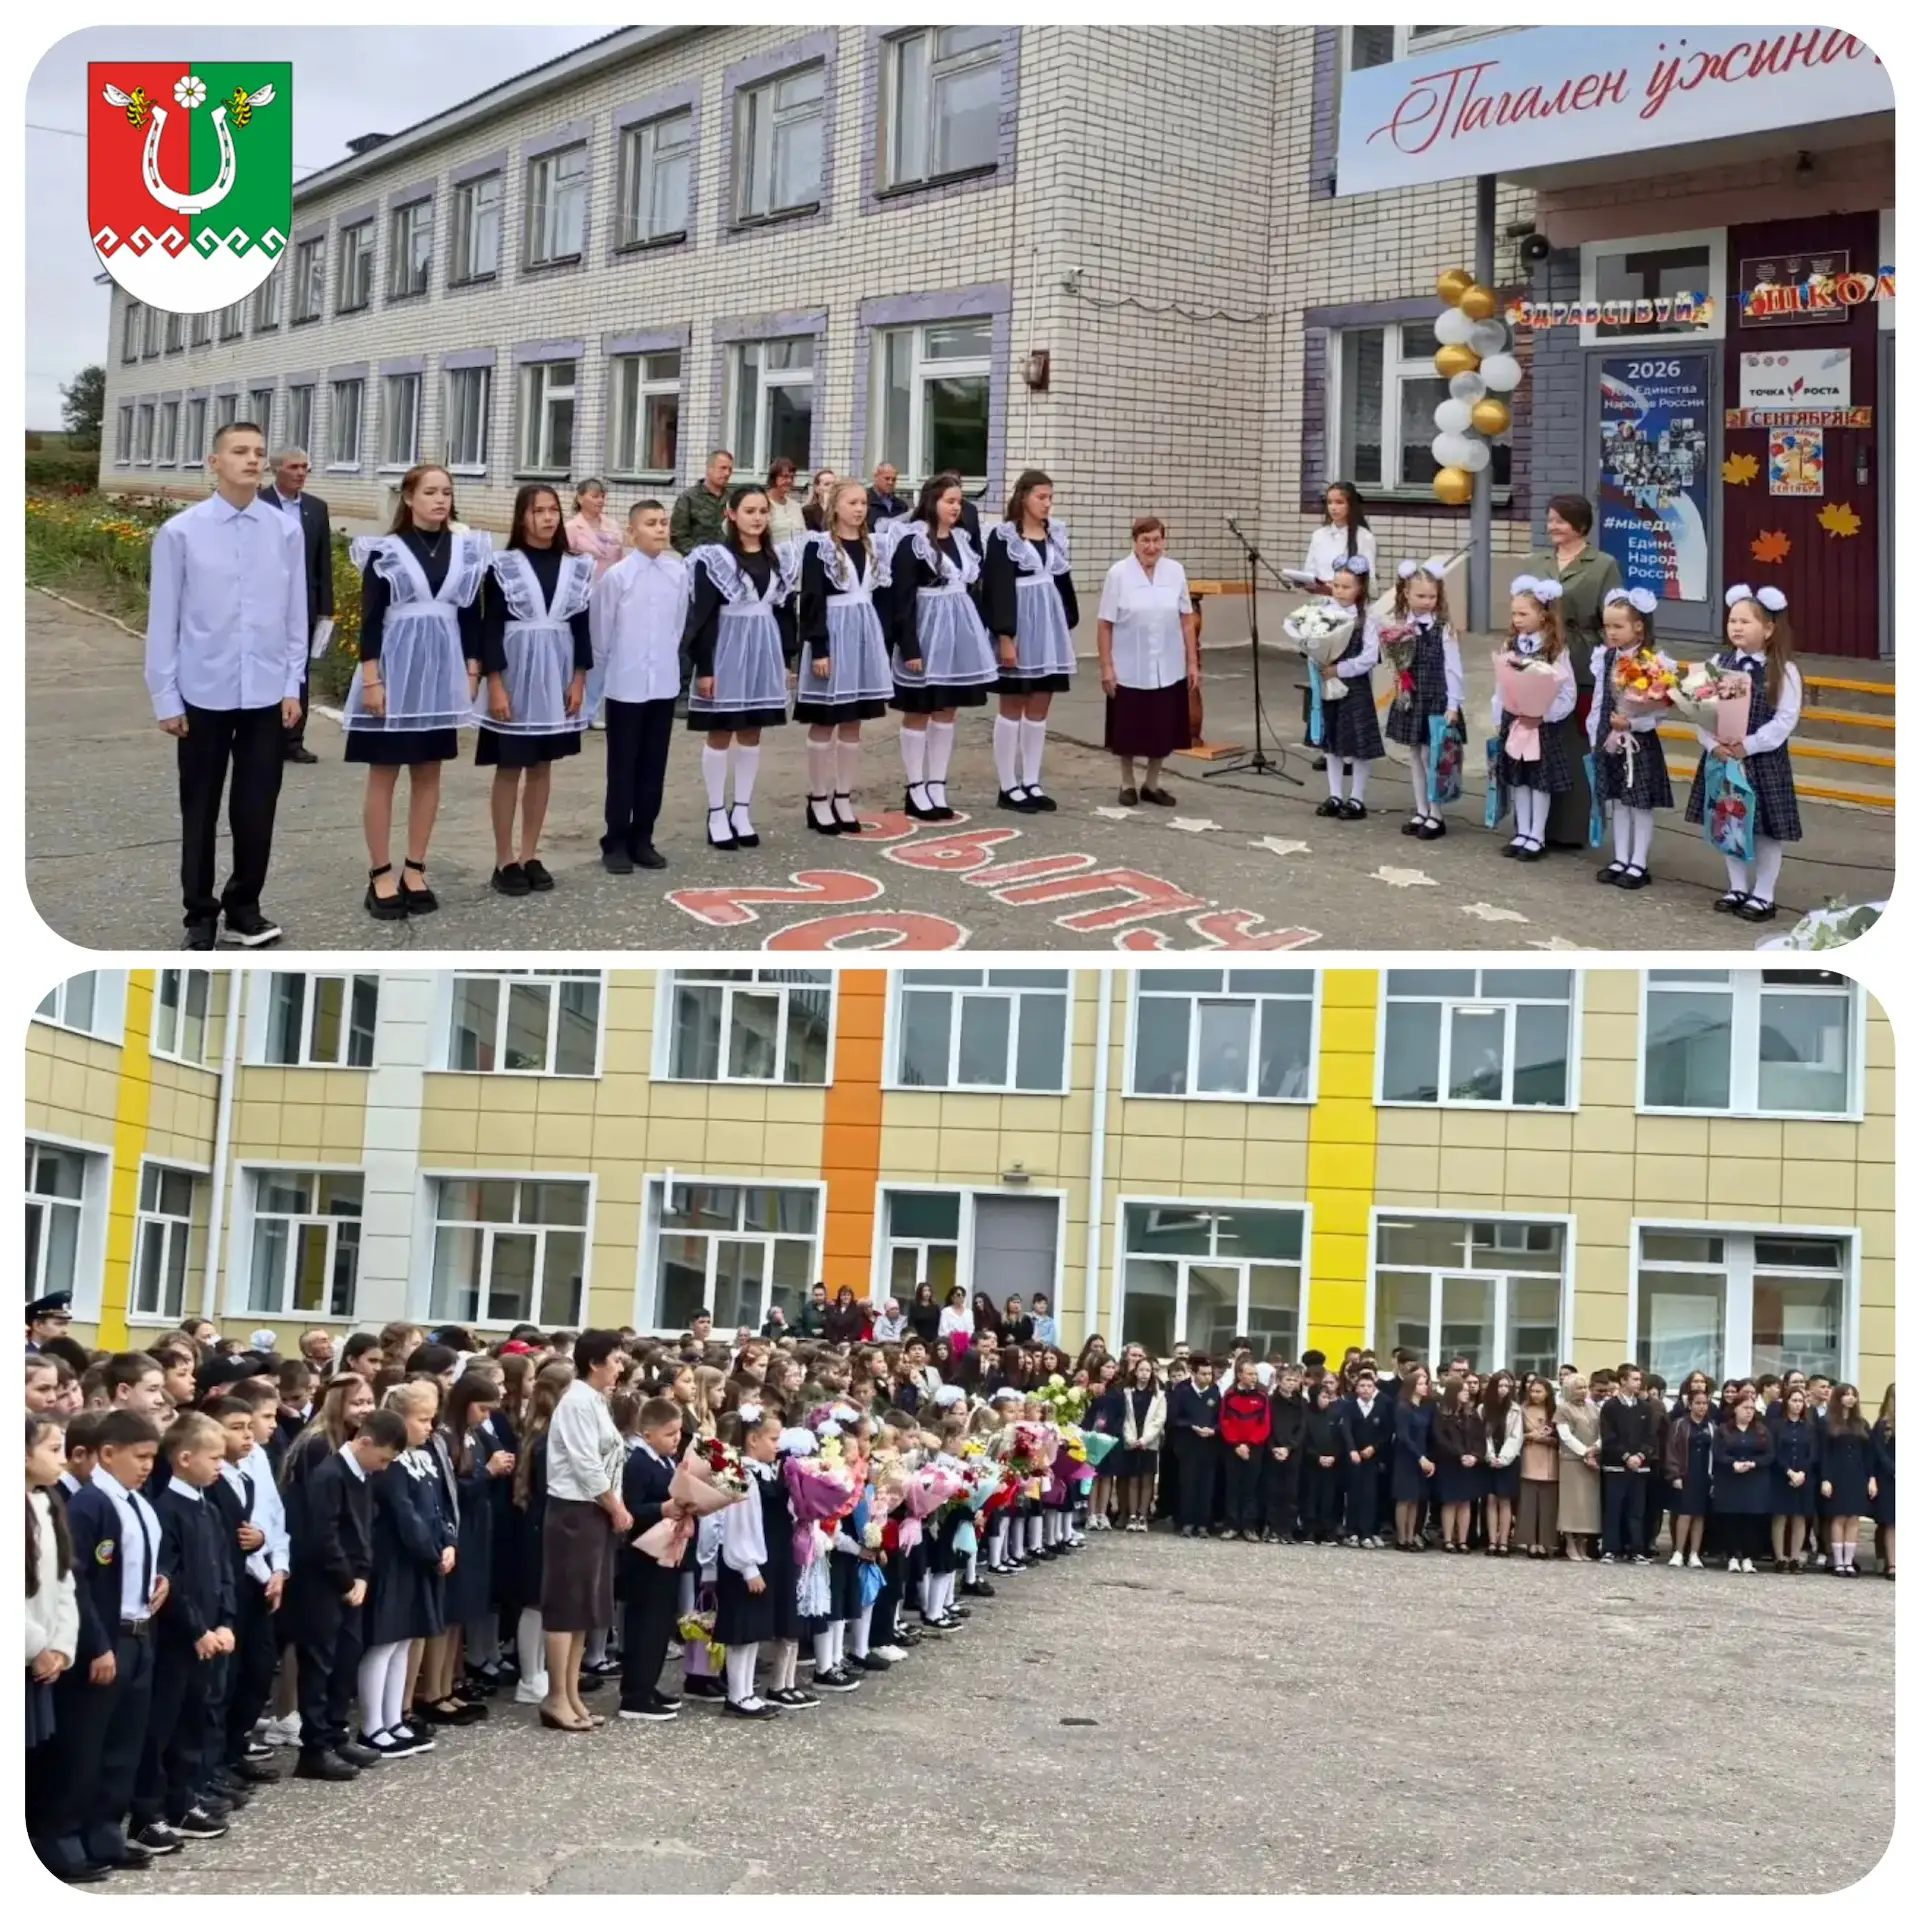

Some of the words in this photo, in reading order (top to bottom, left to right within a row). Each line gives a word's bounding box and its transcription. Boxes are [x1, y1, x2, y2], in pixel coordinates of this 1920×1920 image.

[1366, 60, 1630, 154] Пагален
[1519, 291, 1694, 329] ЗДРАВСТВУЙ
[1627, 361, 1681, 379] 2026
[1635, 384, 1698, 396] Единства
[1803, 387, 1840, 395] РОСТА
[1659, 399, 1705, 408] России
